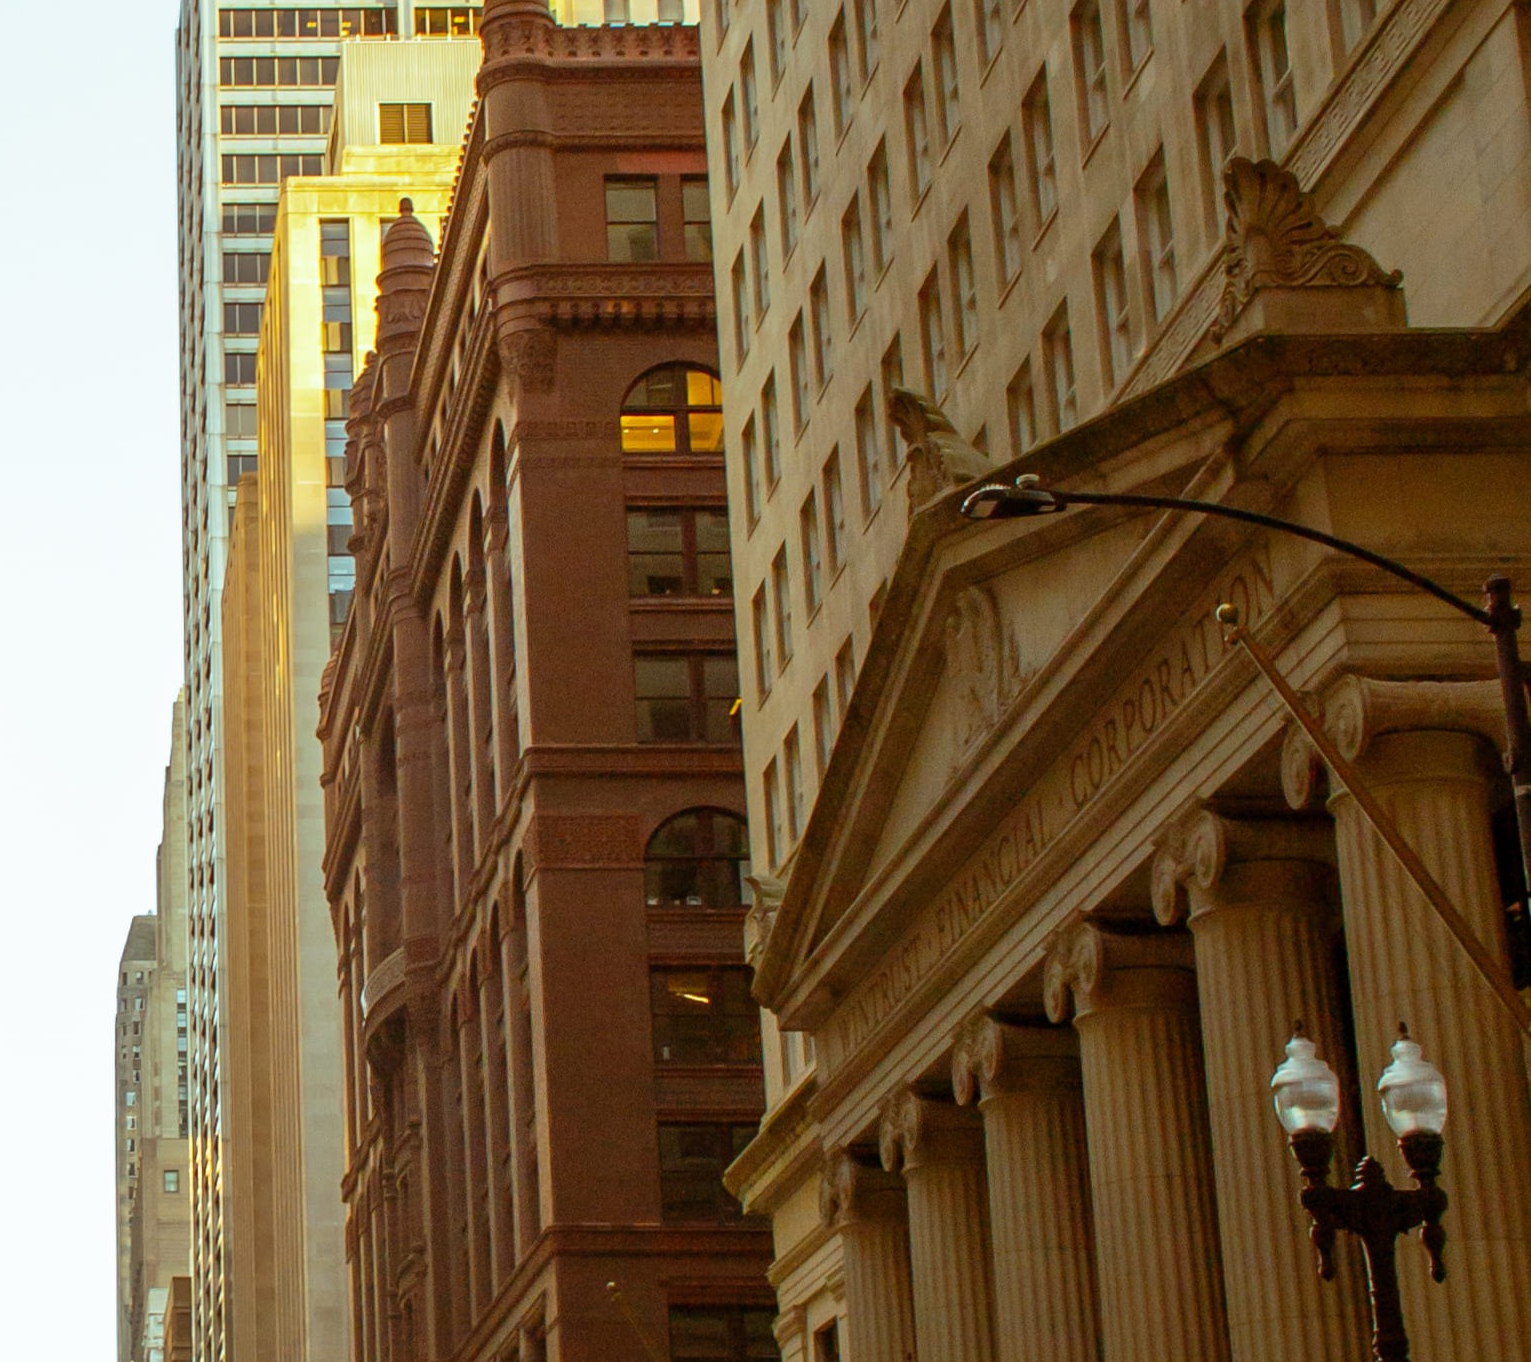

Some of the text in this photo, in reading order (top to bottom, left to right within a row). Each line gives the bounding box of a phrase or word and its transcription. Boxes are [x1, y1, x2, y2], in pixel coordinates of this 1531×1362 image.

[837, 539, 1274, 1059] WINTRUST FINANCIAL CORPORATION
